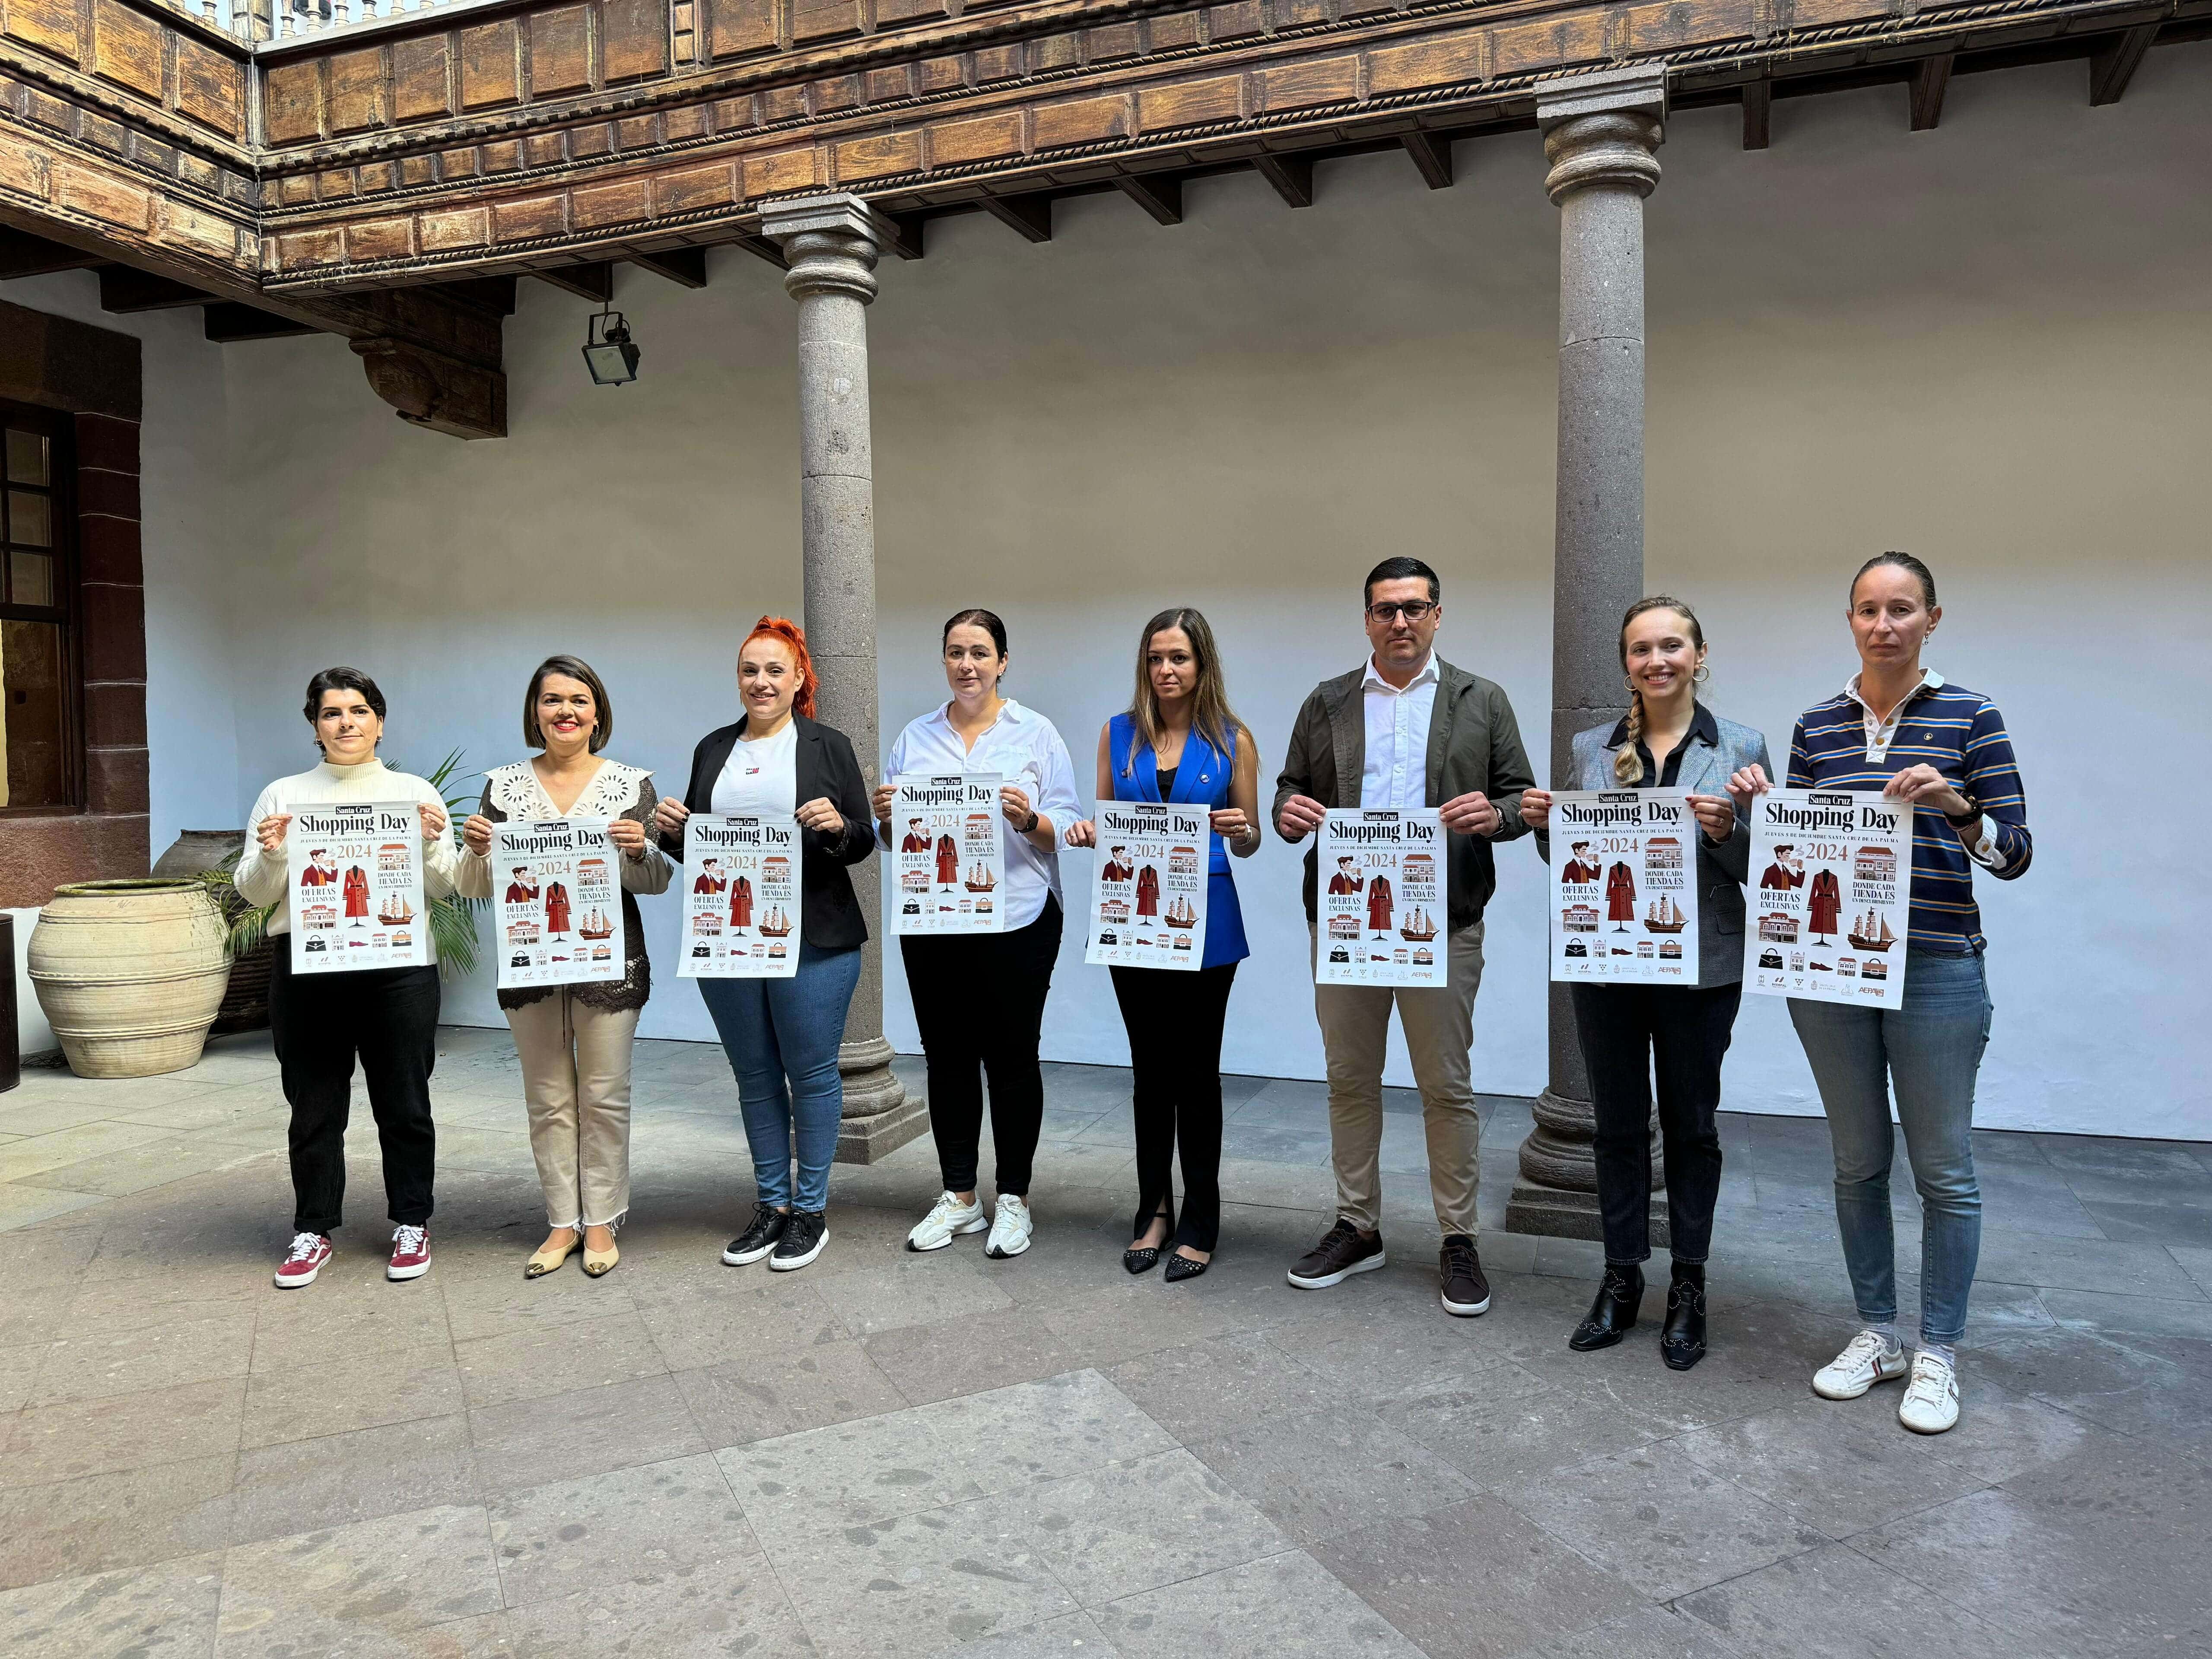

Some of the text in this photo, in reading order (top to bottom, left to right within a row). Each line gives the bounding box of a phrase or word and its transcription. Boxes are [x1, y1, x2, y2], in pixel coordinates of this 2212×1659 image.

[902, 785, 994, 805] Shopping Day
[1600, 793, 1637, 802] Santa Cruz
[1809, 795, 1851, 805] Santa Cruz
[931, 814, 960, 827] 2024
[1562, 802, 1682, 827] Shopping Day
[1766, 803, 1901, 834] Shopping Day
[300, 814, 410, 836] Shopping Day
[535, 823, 553, 832] Santa
[1105, 813, 1201, 837] Shopping Day
[1330, 821, 1437, 843] Shopping Day
[501, 830, 607, 853] Shopping Day
[696, 826, 793, 847] Shopping Day
[337, 844, 372, 858] 2024
[1134, 844, 1164, 858] 2024
[1600, 837, 1638, 853] 2024
[1806, 842, 1848, 861] 2024
[727, 856, 757, 869] 2024
[1363, 854, 1397, 867] 2024
[537, 860, 571, 876] 2024
[302, 887, 336, 896] OFERTAS
[1563, 886, 1598, 894] OFERTAS
[1761, 891, 1800, 902] OFERTAS
[1853, 889, 1895, 899] TIENDA ES
[506, 903, 538, 913] OFERTAS
[1761, 901, 1799, 910] EXCLUSIVAS
